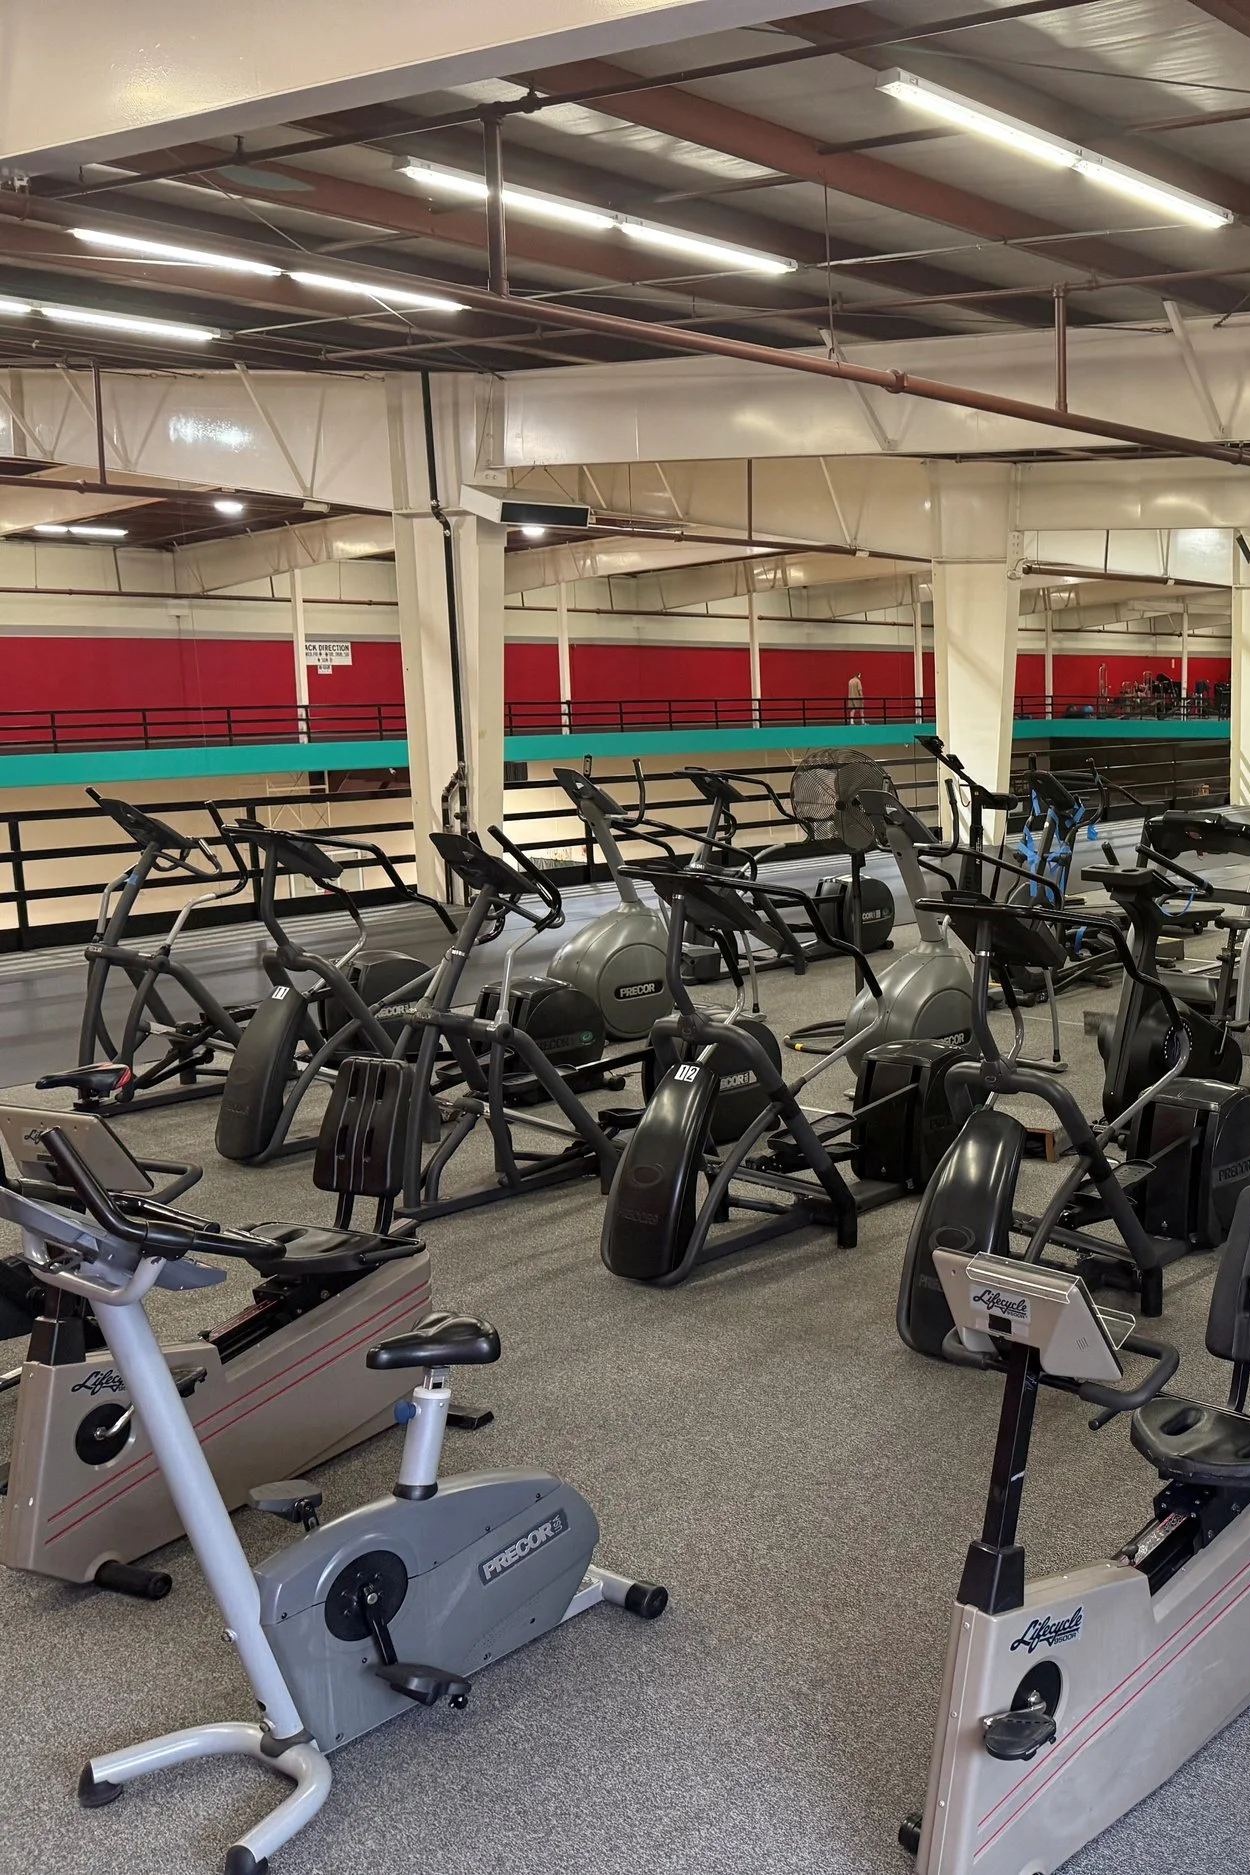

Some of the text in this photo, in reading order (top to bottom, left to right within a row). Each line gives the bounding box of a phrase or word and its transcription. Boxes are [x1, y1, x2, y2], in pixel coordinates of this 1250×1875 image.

[318, 644, 350, 652] DIRECTION
[620, 983, 655, 998] PRECOR
[678, 1065, 699, 1081] 12
[1219, 1159, 1250, 1181] PRECOR
[973, 1289, 1027, 1315] Lifecycle
[483, 1514, 563, 1580] PRECOR USA
[1010, 1606, 1082, 1655] Lifecycle
